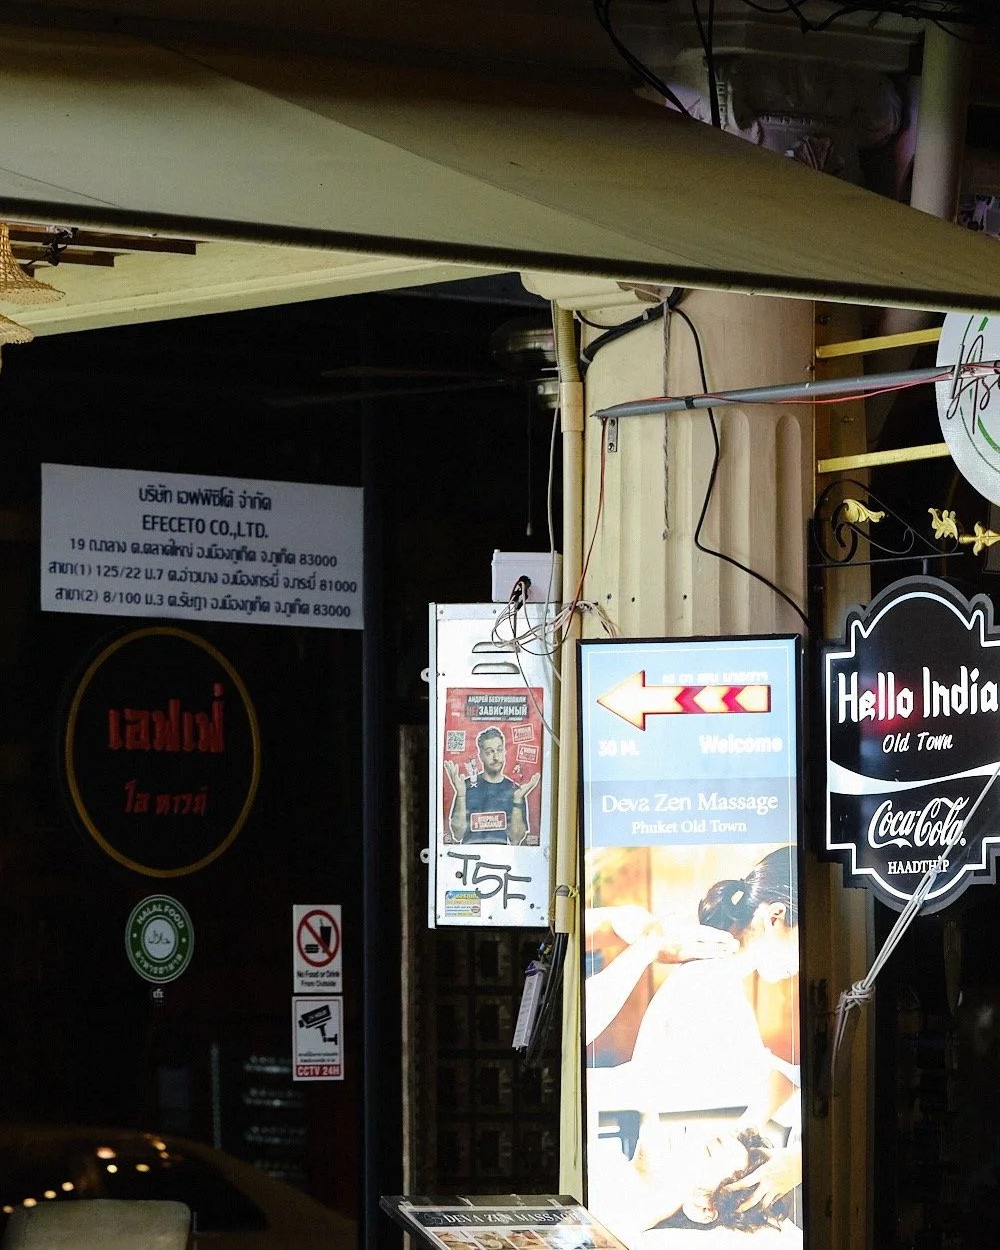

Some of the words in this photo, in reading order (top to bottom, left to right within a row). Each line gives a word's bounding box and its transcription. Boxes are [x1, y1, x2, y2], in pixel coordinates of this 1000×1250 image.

[142, 514, 206, 534] EFECETO
[209, 519, 269, 540] CO.,LTD.
[70, 537, 85, 551] 19
[299, 553, 338, 567] 83000
[95, 564, 142, 581] 125/22
[319, 579, 358, 593] 81000
[103, 590, 142, 605] 8/100
[313, 604, 351, 618] 83000
[837, 670, 914, 724] Hello
[922, 665, 1000, 719] India
[699, 733, 783, 755] Welcome
[882, 732, 911, 754] Old
[916, 731, 954, 752] Town
[601, 794, 650, 813] Deva
[654, 793, 692, 812] Zen
[696, 792, 779, 816] Massage
[631, 820, 678, 836] Phuket
[680, 819, 707, 834] Old
[709, 819, 748, 833] Town
[867, 796, 970, 850] Coca-Cola
[887, 858, 950, 876] HAADTHP
[297, 1065, 319, 1077] CCTV
[444, 1213, 484, 1224] DEVA
